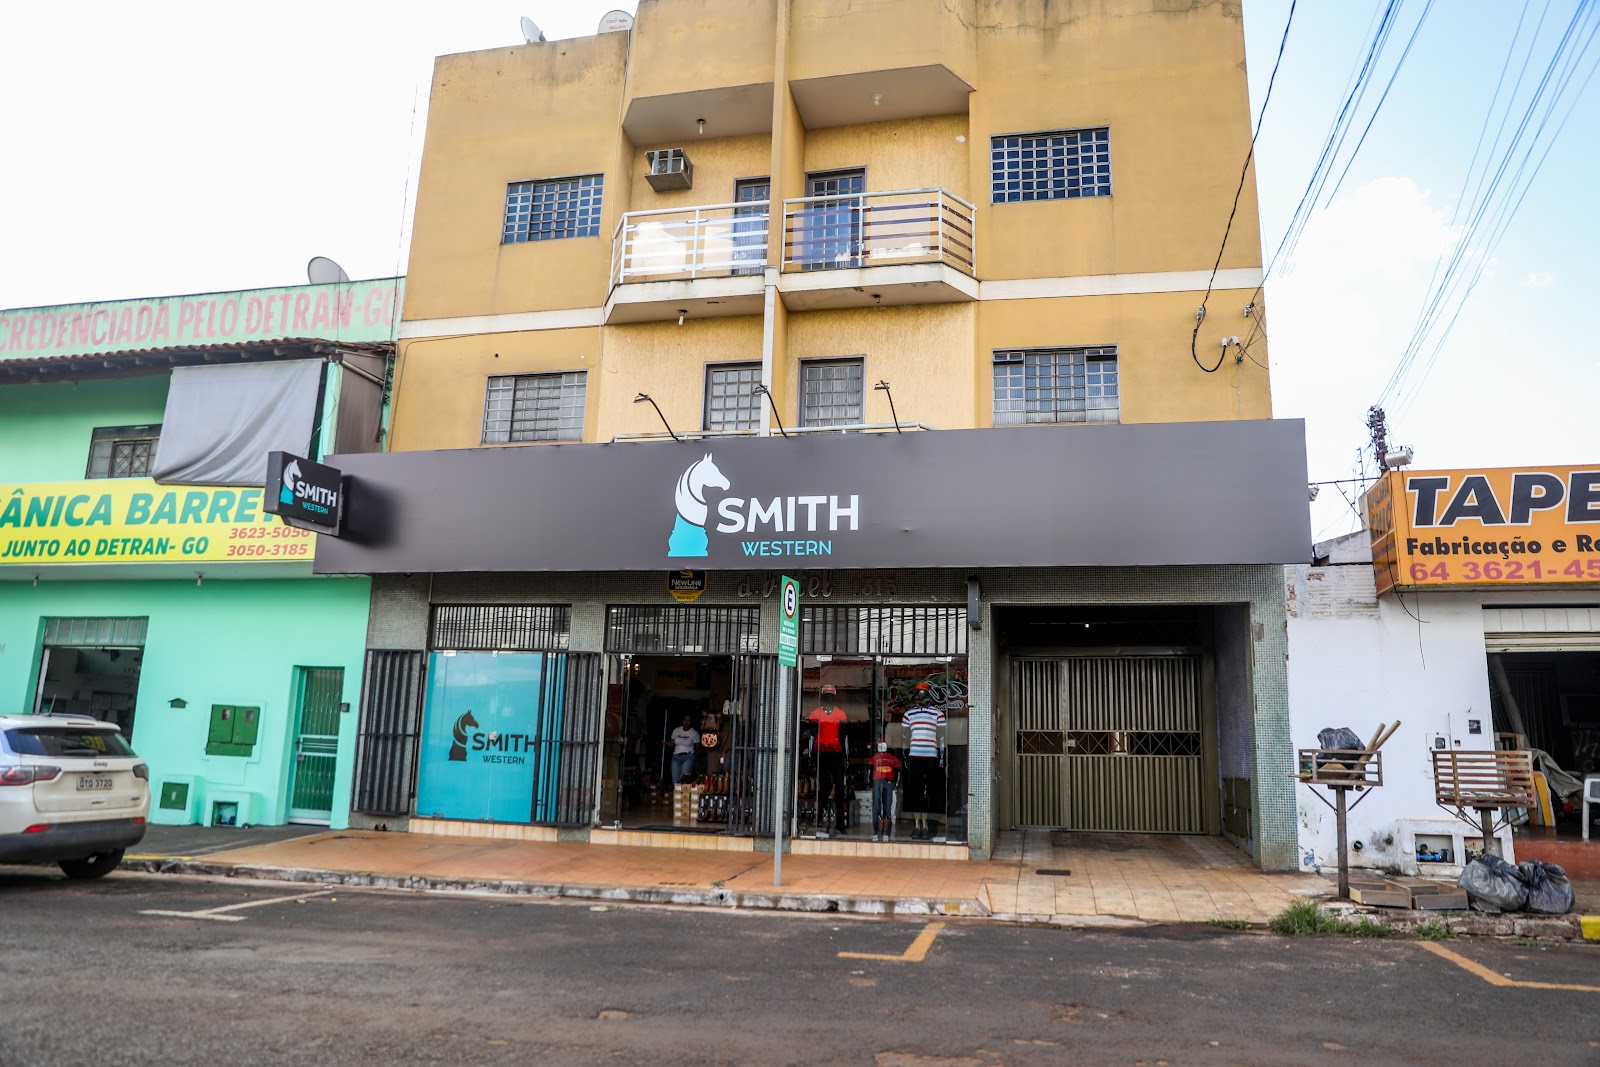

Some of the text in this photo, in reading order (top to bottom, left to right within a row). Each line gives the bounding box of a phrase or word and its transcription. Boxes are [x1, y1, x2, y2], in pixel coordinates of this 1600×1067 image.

[176, 298, 239, 341] PELO
[245, 286, 400, 335] DETRAN-GO
[295, 481, 337, 507] SMITH
[1406, 470, 1600, 528] TAPE
[125, 489, 274, 525] BARRE
[302, 501, 329, 515] WESTERN
[716, 494, 859, 533] SMITH
[1, 539, 60, 557] JUNTO
[63, 538, 91, 556] AO
[181, 536, 209, 555] GO
[227, 544, 308, 556] 3050-3185
[741, 540, 832, 556] WESTERN
[1406, 535, 1542, 560] Fabricação
[1552, 539, 1567, 553] e
[1409, 562, 1450, 581] 64
[1462, 559, 1600, 581] 3621-45
[472, 732, 537, 753] SMITH
[483, 755, 525, 765] WESTERN
